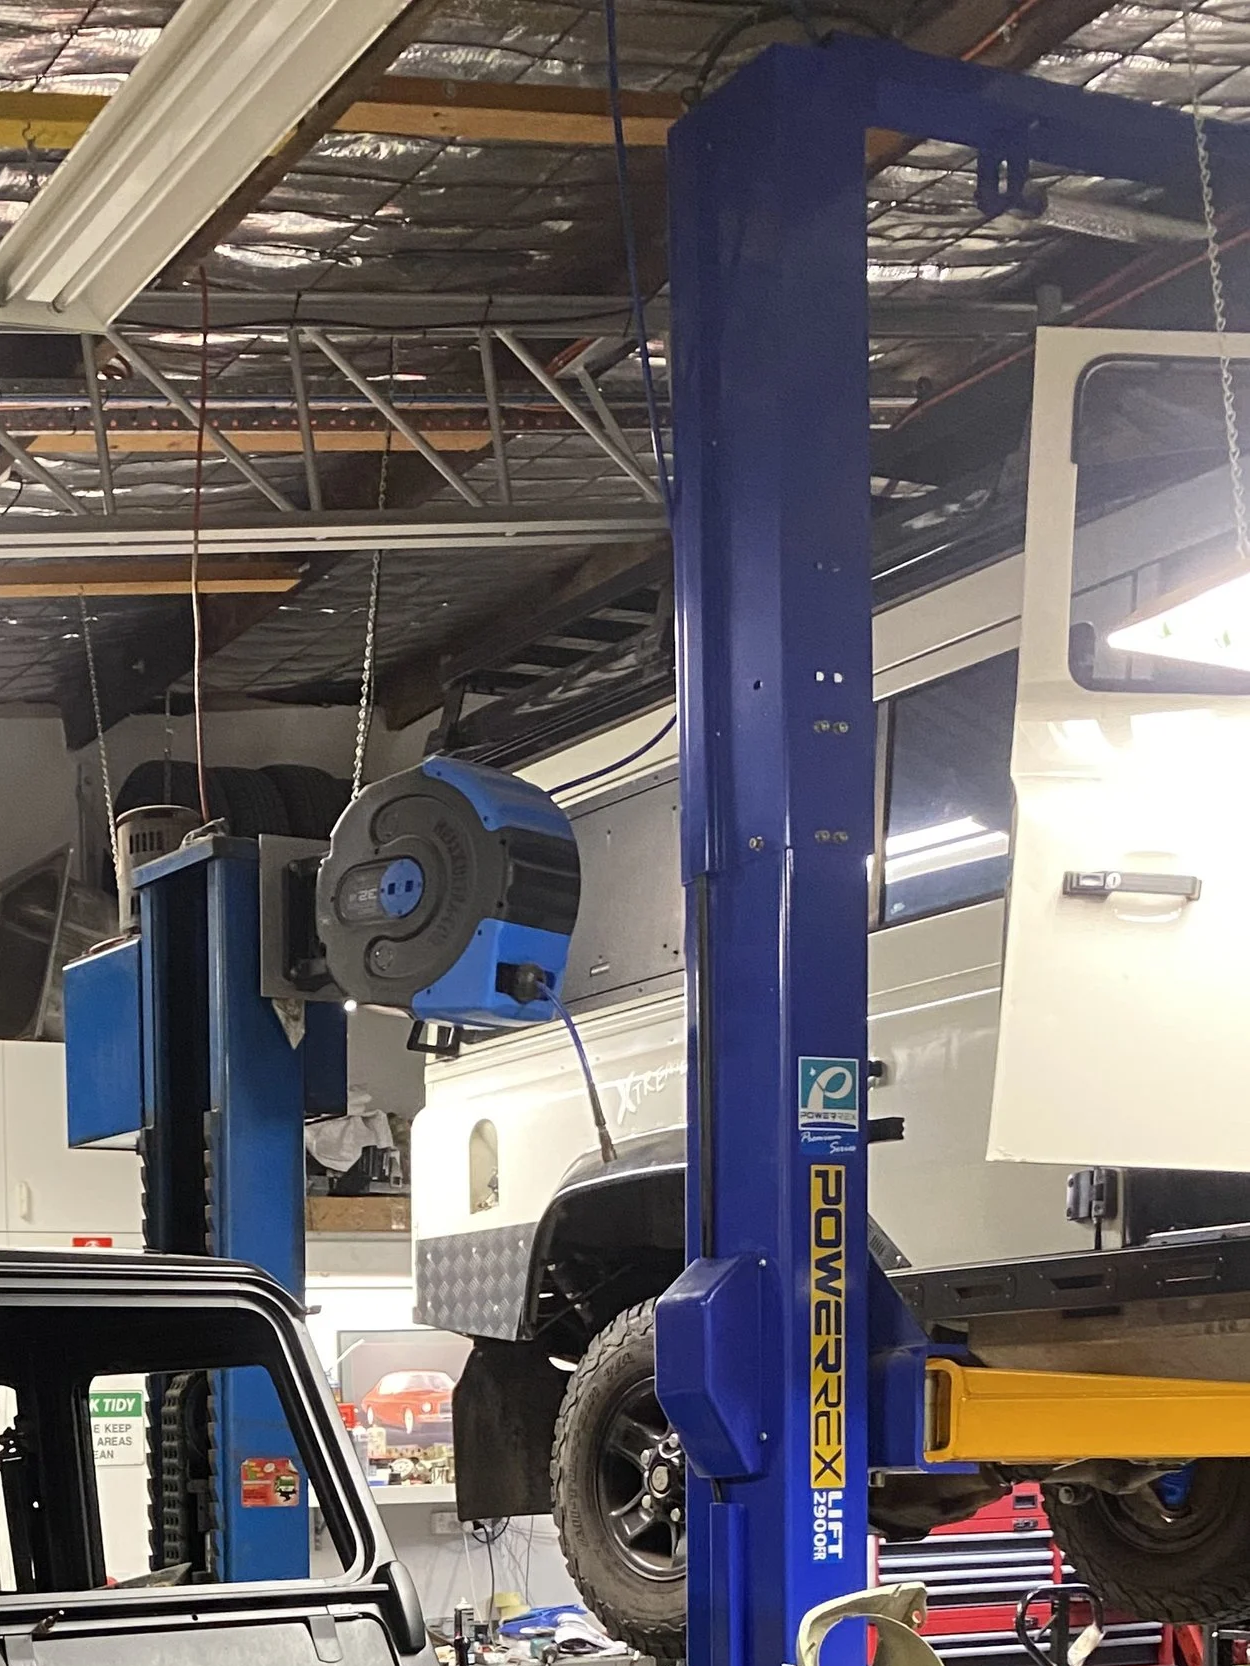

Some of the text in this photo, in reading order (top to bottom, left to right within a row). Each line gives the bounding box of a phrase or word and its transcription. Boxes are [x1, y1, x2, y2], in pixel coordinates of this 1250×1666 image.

[814, 1169, 842, 1482] POWERREX
[103, 1398, 136, 1412] TIDY
[104, 1424, 132, 1433] KEEP
[97, 1437, 132, 1446] AREAS
[827, 1491, 843, 1559] LIFT
